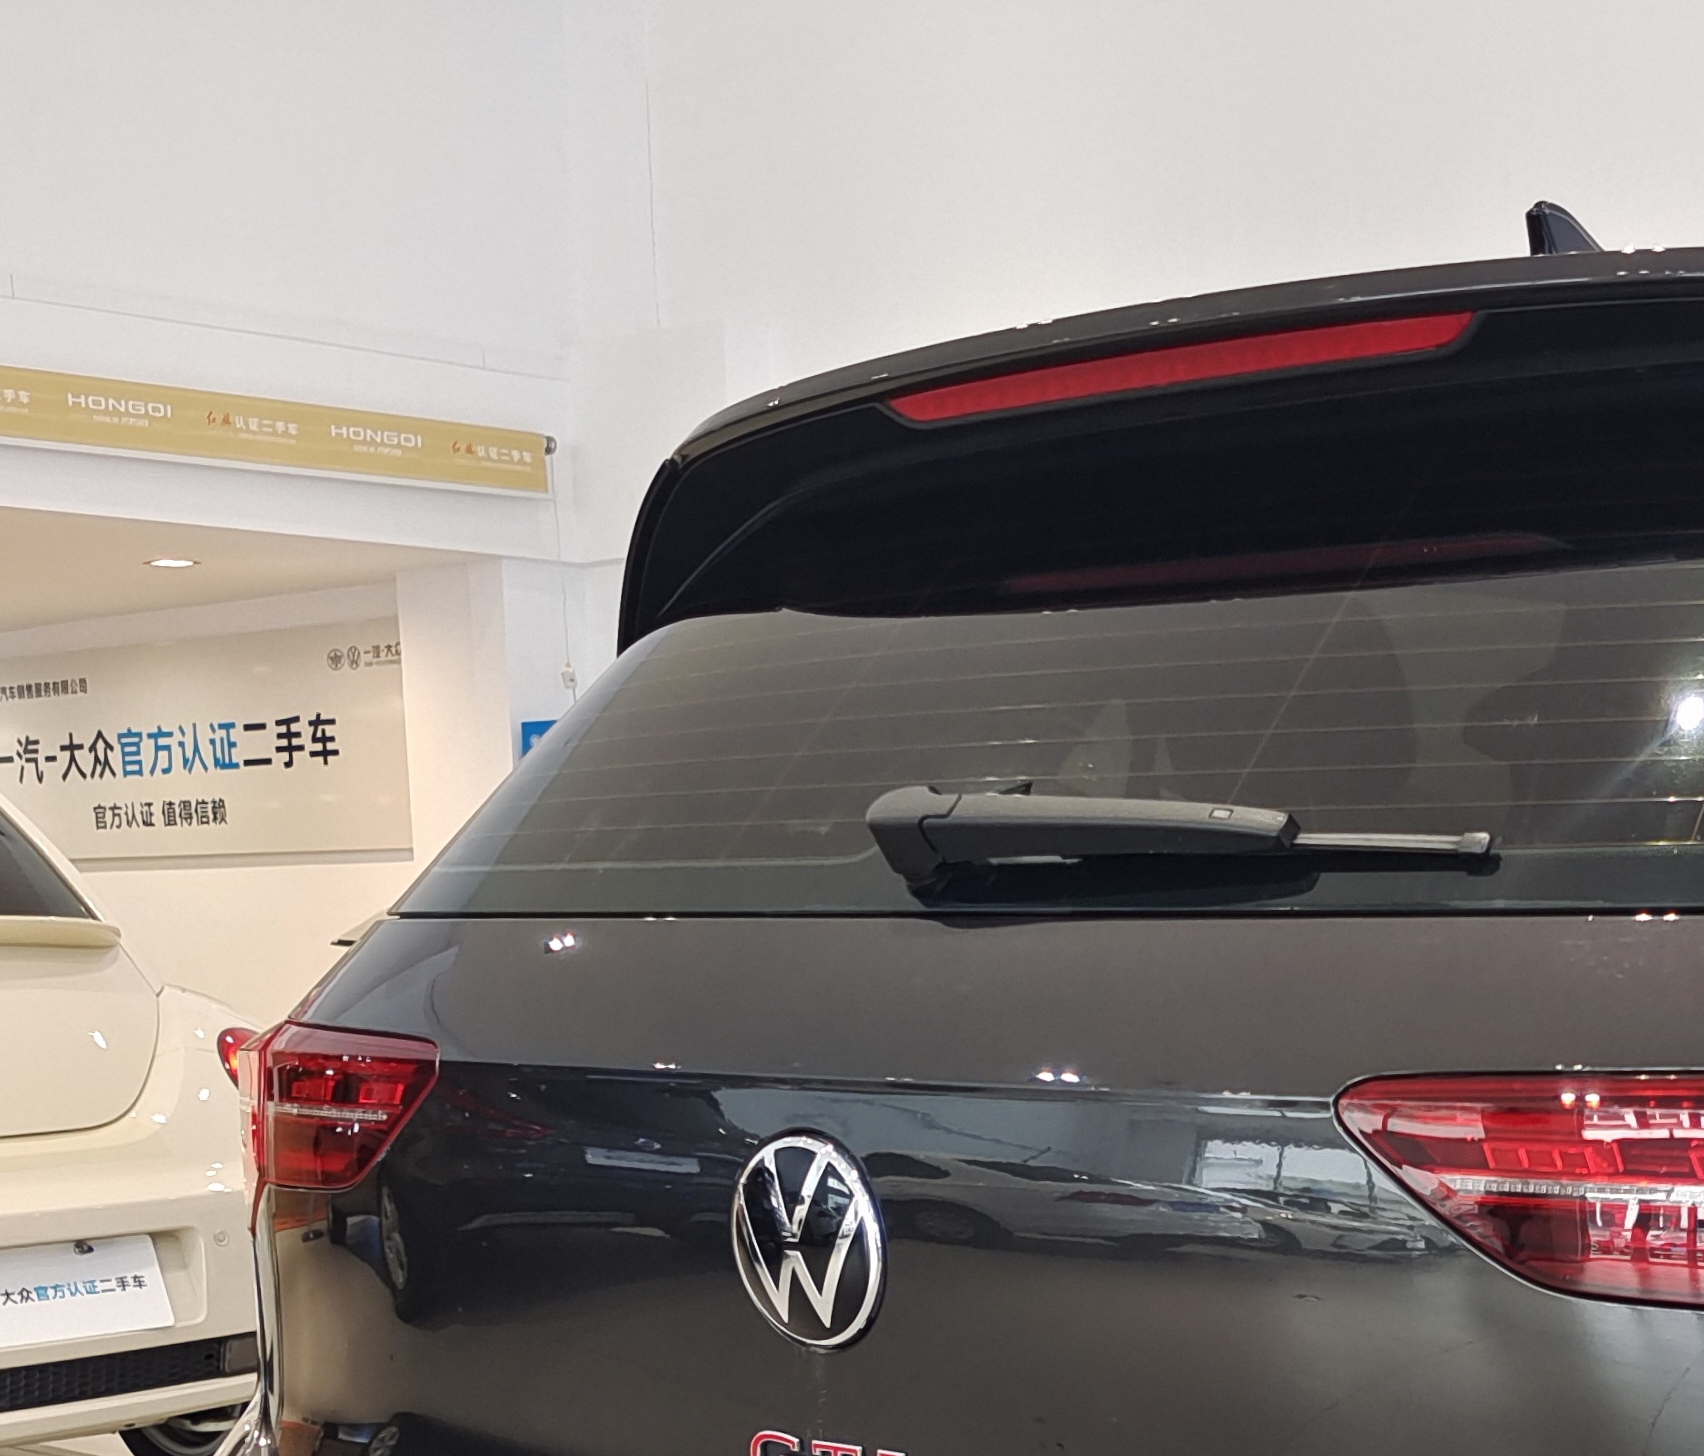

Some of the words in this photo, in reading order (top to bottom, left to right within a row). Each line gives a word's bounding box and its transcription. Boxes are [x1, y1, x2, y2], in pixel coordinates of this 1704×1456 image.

[67, 392, 172, 418] HONGQI
[330, 424, 422, 448] HONGQI
[93, 802, 156, 830] 官方认证
[162, 797, 228, 827] 值得信赖
[0, 1274, 147, 1306] 大众官方认证二手车
